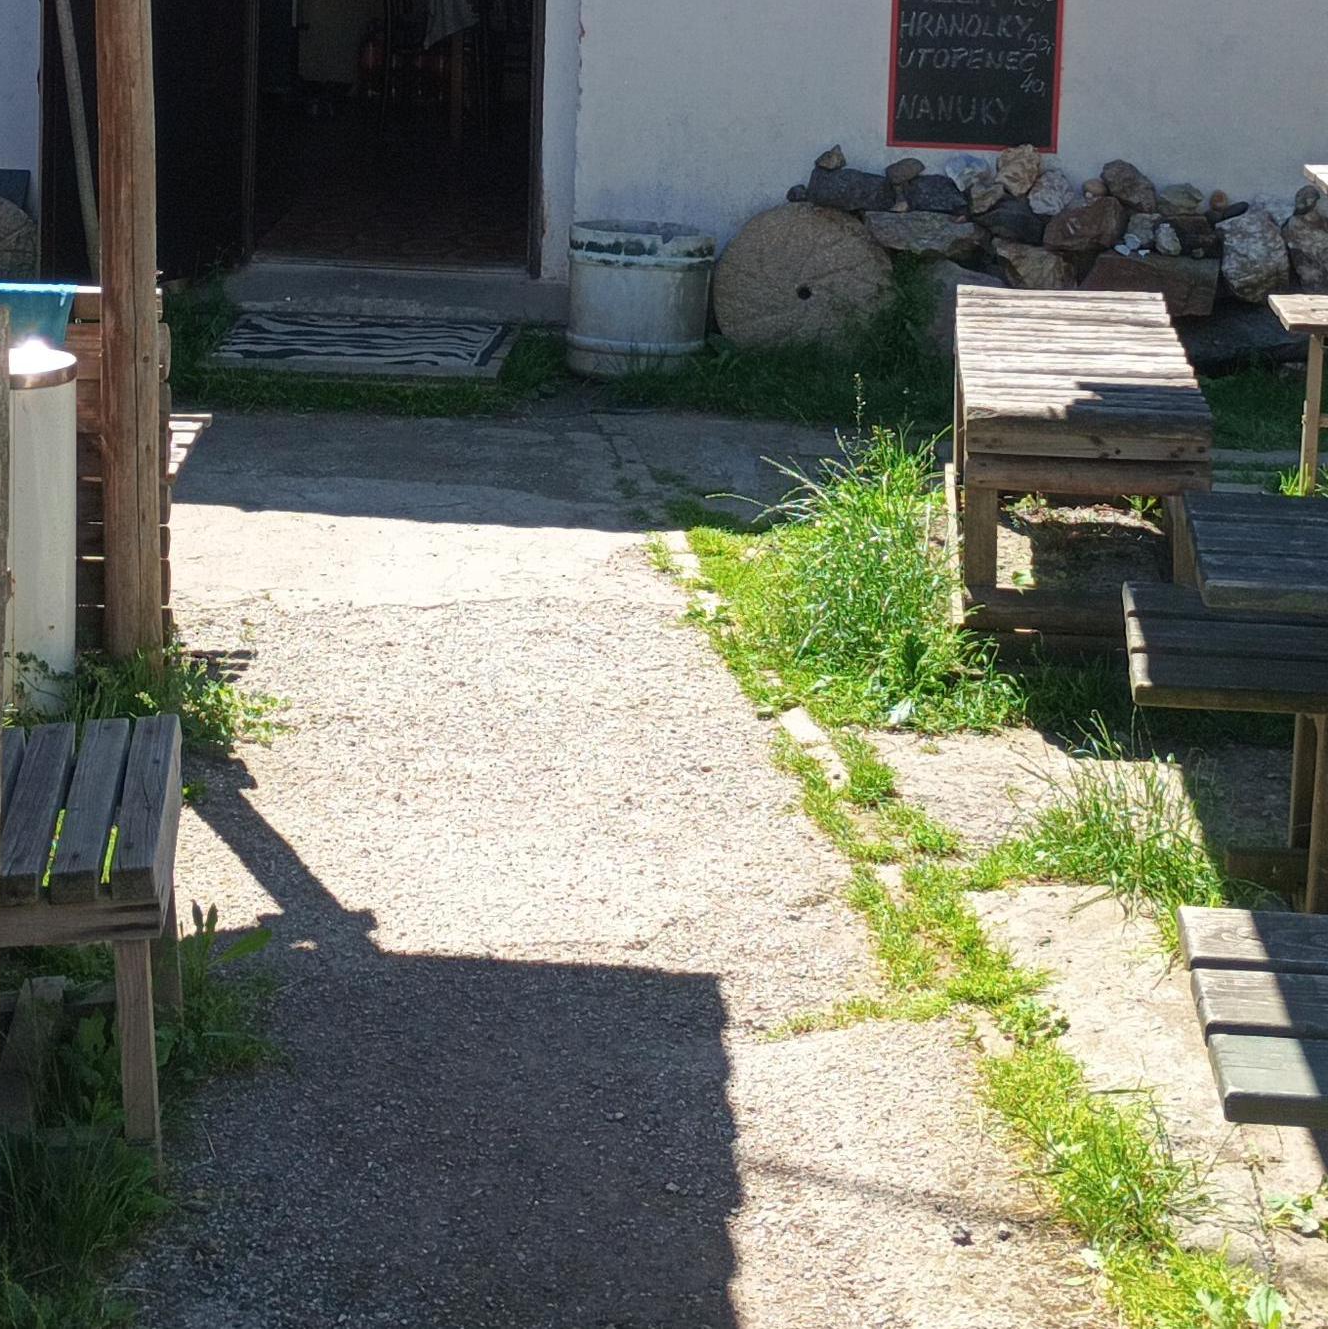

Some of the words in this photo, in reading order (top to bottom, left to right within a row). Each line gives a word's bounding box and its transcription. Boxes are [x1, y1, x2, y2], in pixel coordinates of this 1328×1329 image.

[898, 10, 1035, 40] HRANOLKY
[897, 47, 1038, 73] UTOPENEC
[895, 94, 1012, 130] NANUKY
